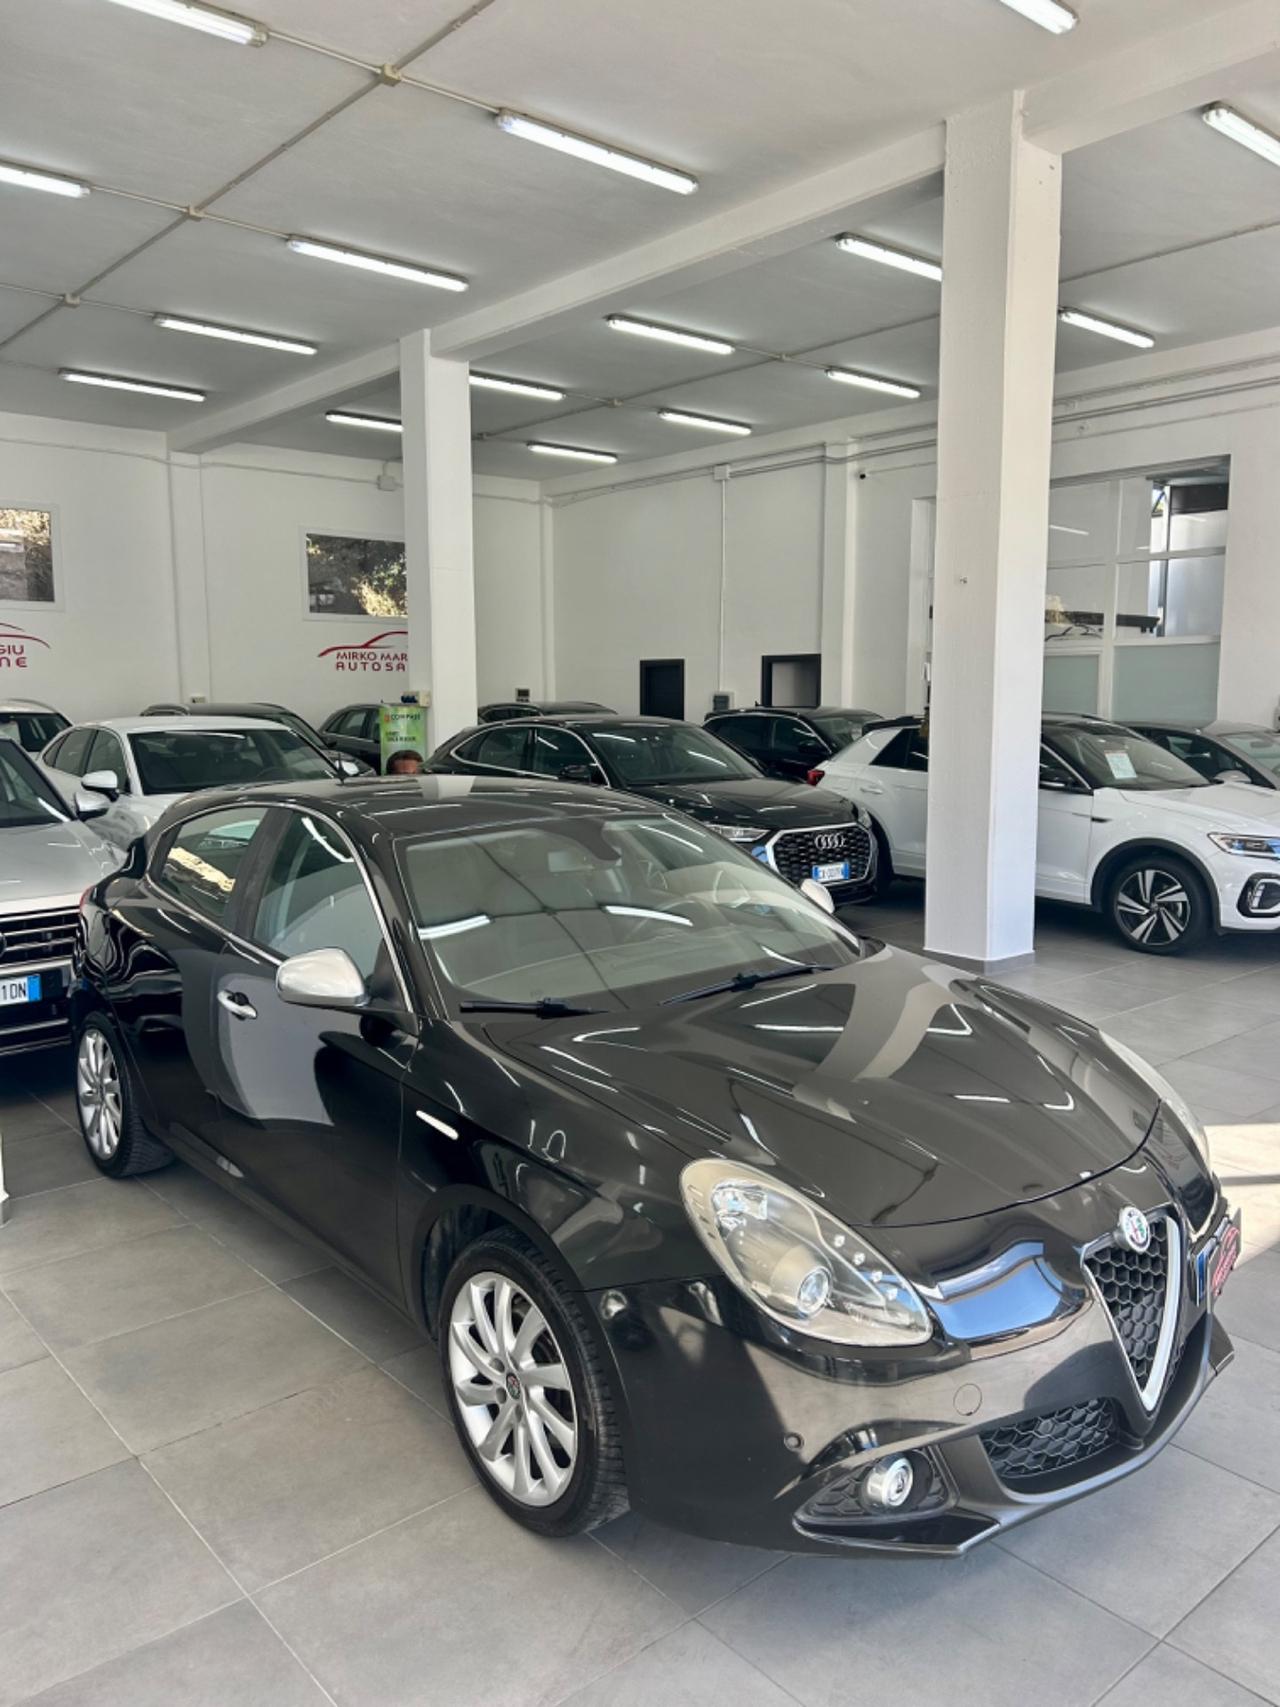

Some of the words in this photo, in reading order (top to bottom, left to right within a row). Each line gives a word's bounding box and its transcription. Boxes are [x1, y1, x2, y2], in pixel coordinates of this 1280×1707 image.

[336, 651, 377, 661] MIRKO
[380, 652, 408, 662] MAR
[336, 661, 406, 672] AUTOSA
